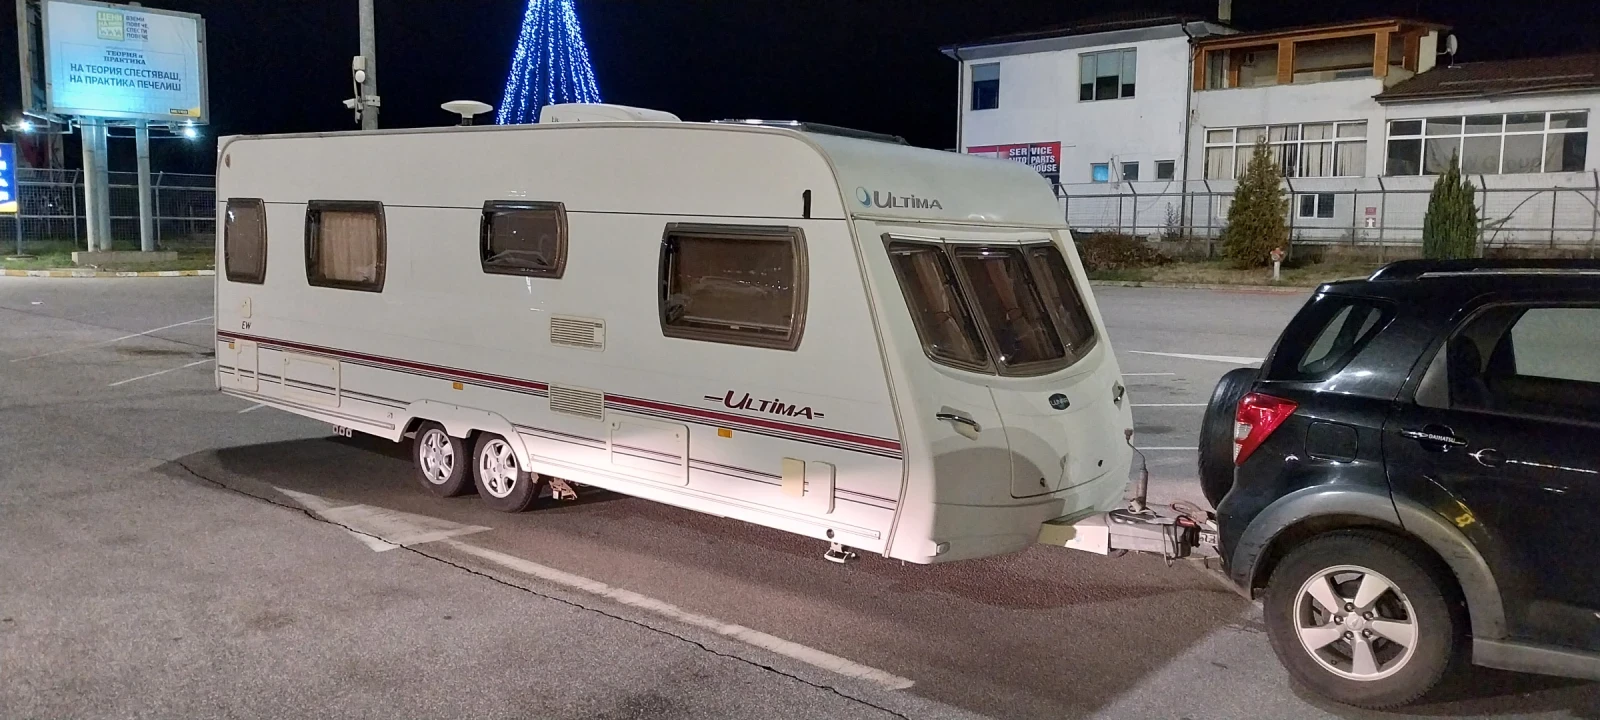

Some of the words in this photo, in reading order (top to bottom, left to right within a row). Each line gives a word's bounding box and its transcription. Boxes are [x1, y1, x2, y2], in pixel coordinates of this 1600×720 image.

[106, 50, 137, 59] ТЕОРИЯ
[103, 56, 146, 65] ПРАКТИКА
[70, 63, 84, 73] НА
[86, 64, 122, 76] ТЕОРИЯ
[124, 68, 181, 82] СПЕСТЯВАШ,
[69, 74, 83, 84] НА
[85, 76, 135, 88] ПРАКТИКА
[137, 80, 181, 91] ПЕЧЕЛИШ
[1030, 155, 1056, 164] PARTS
[241, 321, 252, 330] EW
[1428, 434, 1456, 443] DAIHATSU
